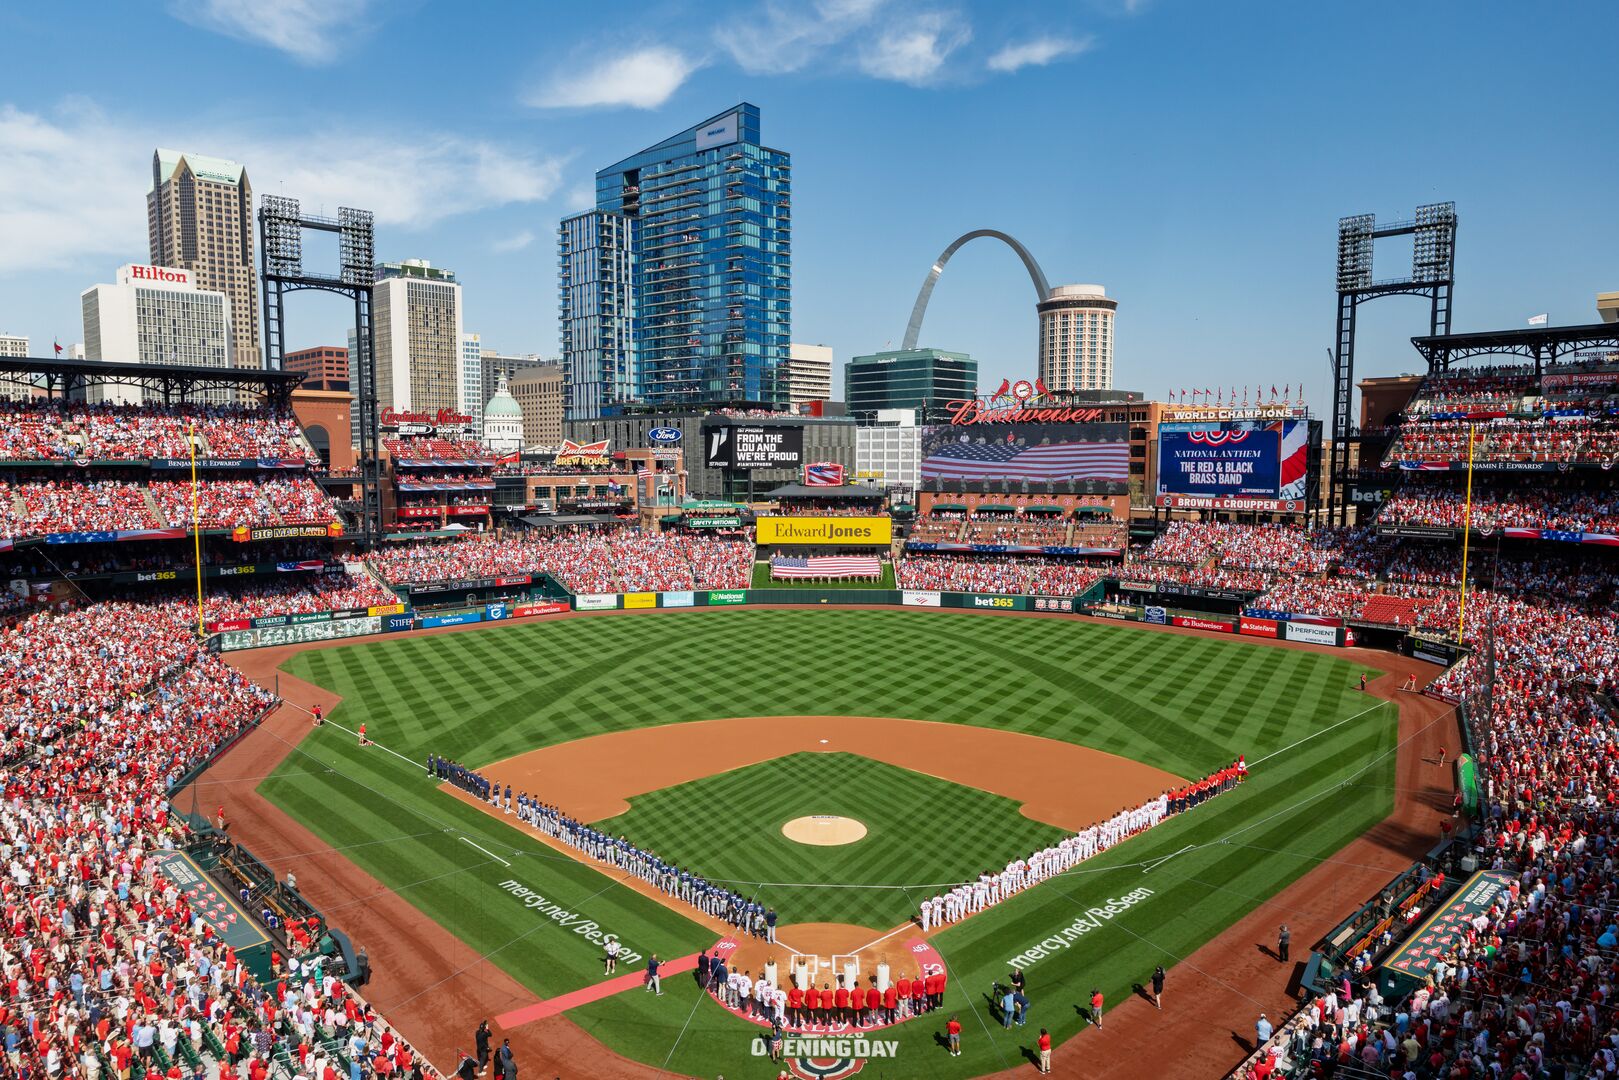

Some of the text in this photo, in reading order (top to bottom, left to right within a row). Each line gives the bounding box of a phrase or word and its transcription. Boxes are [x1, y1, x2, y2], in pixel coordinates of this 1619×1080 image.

[131, 265, 188, 283] Hilton
[381, 406, 473, 427] Cardinals Nation
[946, 400, 1101, 425] Budweiser
[1173, 409, 1293, 420] WORLD CHAMPIONS
[656, 429, 676, 439] Ford
[737, 434, 783, 443] FROM THE
[559, 446, 607, 458] Budweiser
[737, 443, 776, 452] LOU AND
[737, 452, 798, 461] WE'RE PROUD
[1174, 450, 1261, 458] NATIONAL ANTHEM
[556, 457, 610, 466] BREW HOUSE
[1507, 462, 1545, 470] EDWARDS
[1180, 462, 1253, 474] THE RED & BLACK
[1189, 473, 1243, 484] BRASS BAND
[1178, 498, 1212, 507] BROWN
[1224, 499, 1278, 509] CROUPPEN
[252, 527, 327, 540] BIG MAC LAND
[775, 523, 871, 539] Edward Jones
[137, 571, 176, 582] bet365
[220, 566, 255, 576] bet365
[975, 596, 1014, 607] bet365
[533, 607, 561, 616] Budweiser
[1191, 620, 1223, 630] Budweiser
[1295, 627, 1335, 637] PERFICIENT
[498, 879, 642, 965] mercy.net/BeSen
[1006, 886, 1155, 970] mercy.net/BeSeen
[751, 1038, 899, 1060] OENING DAY
